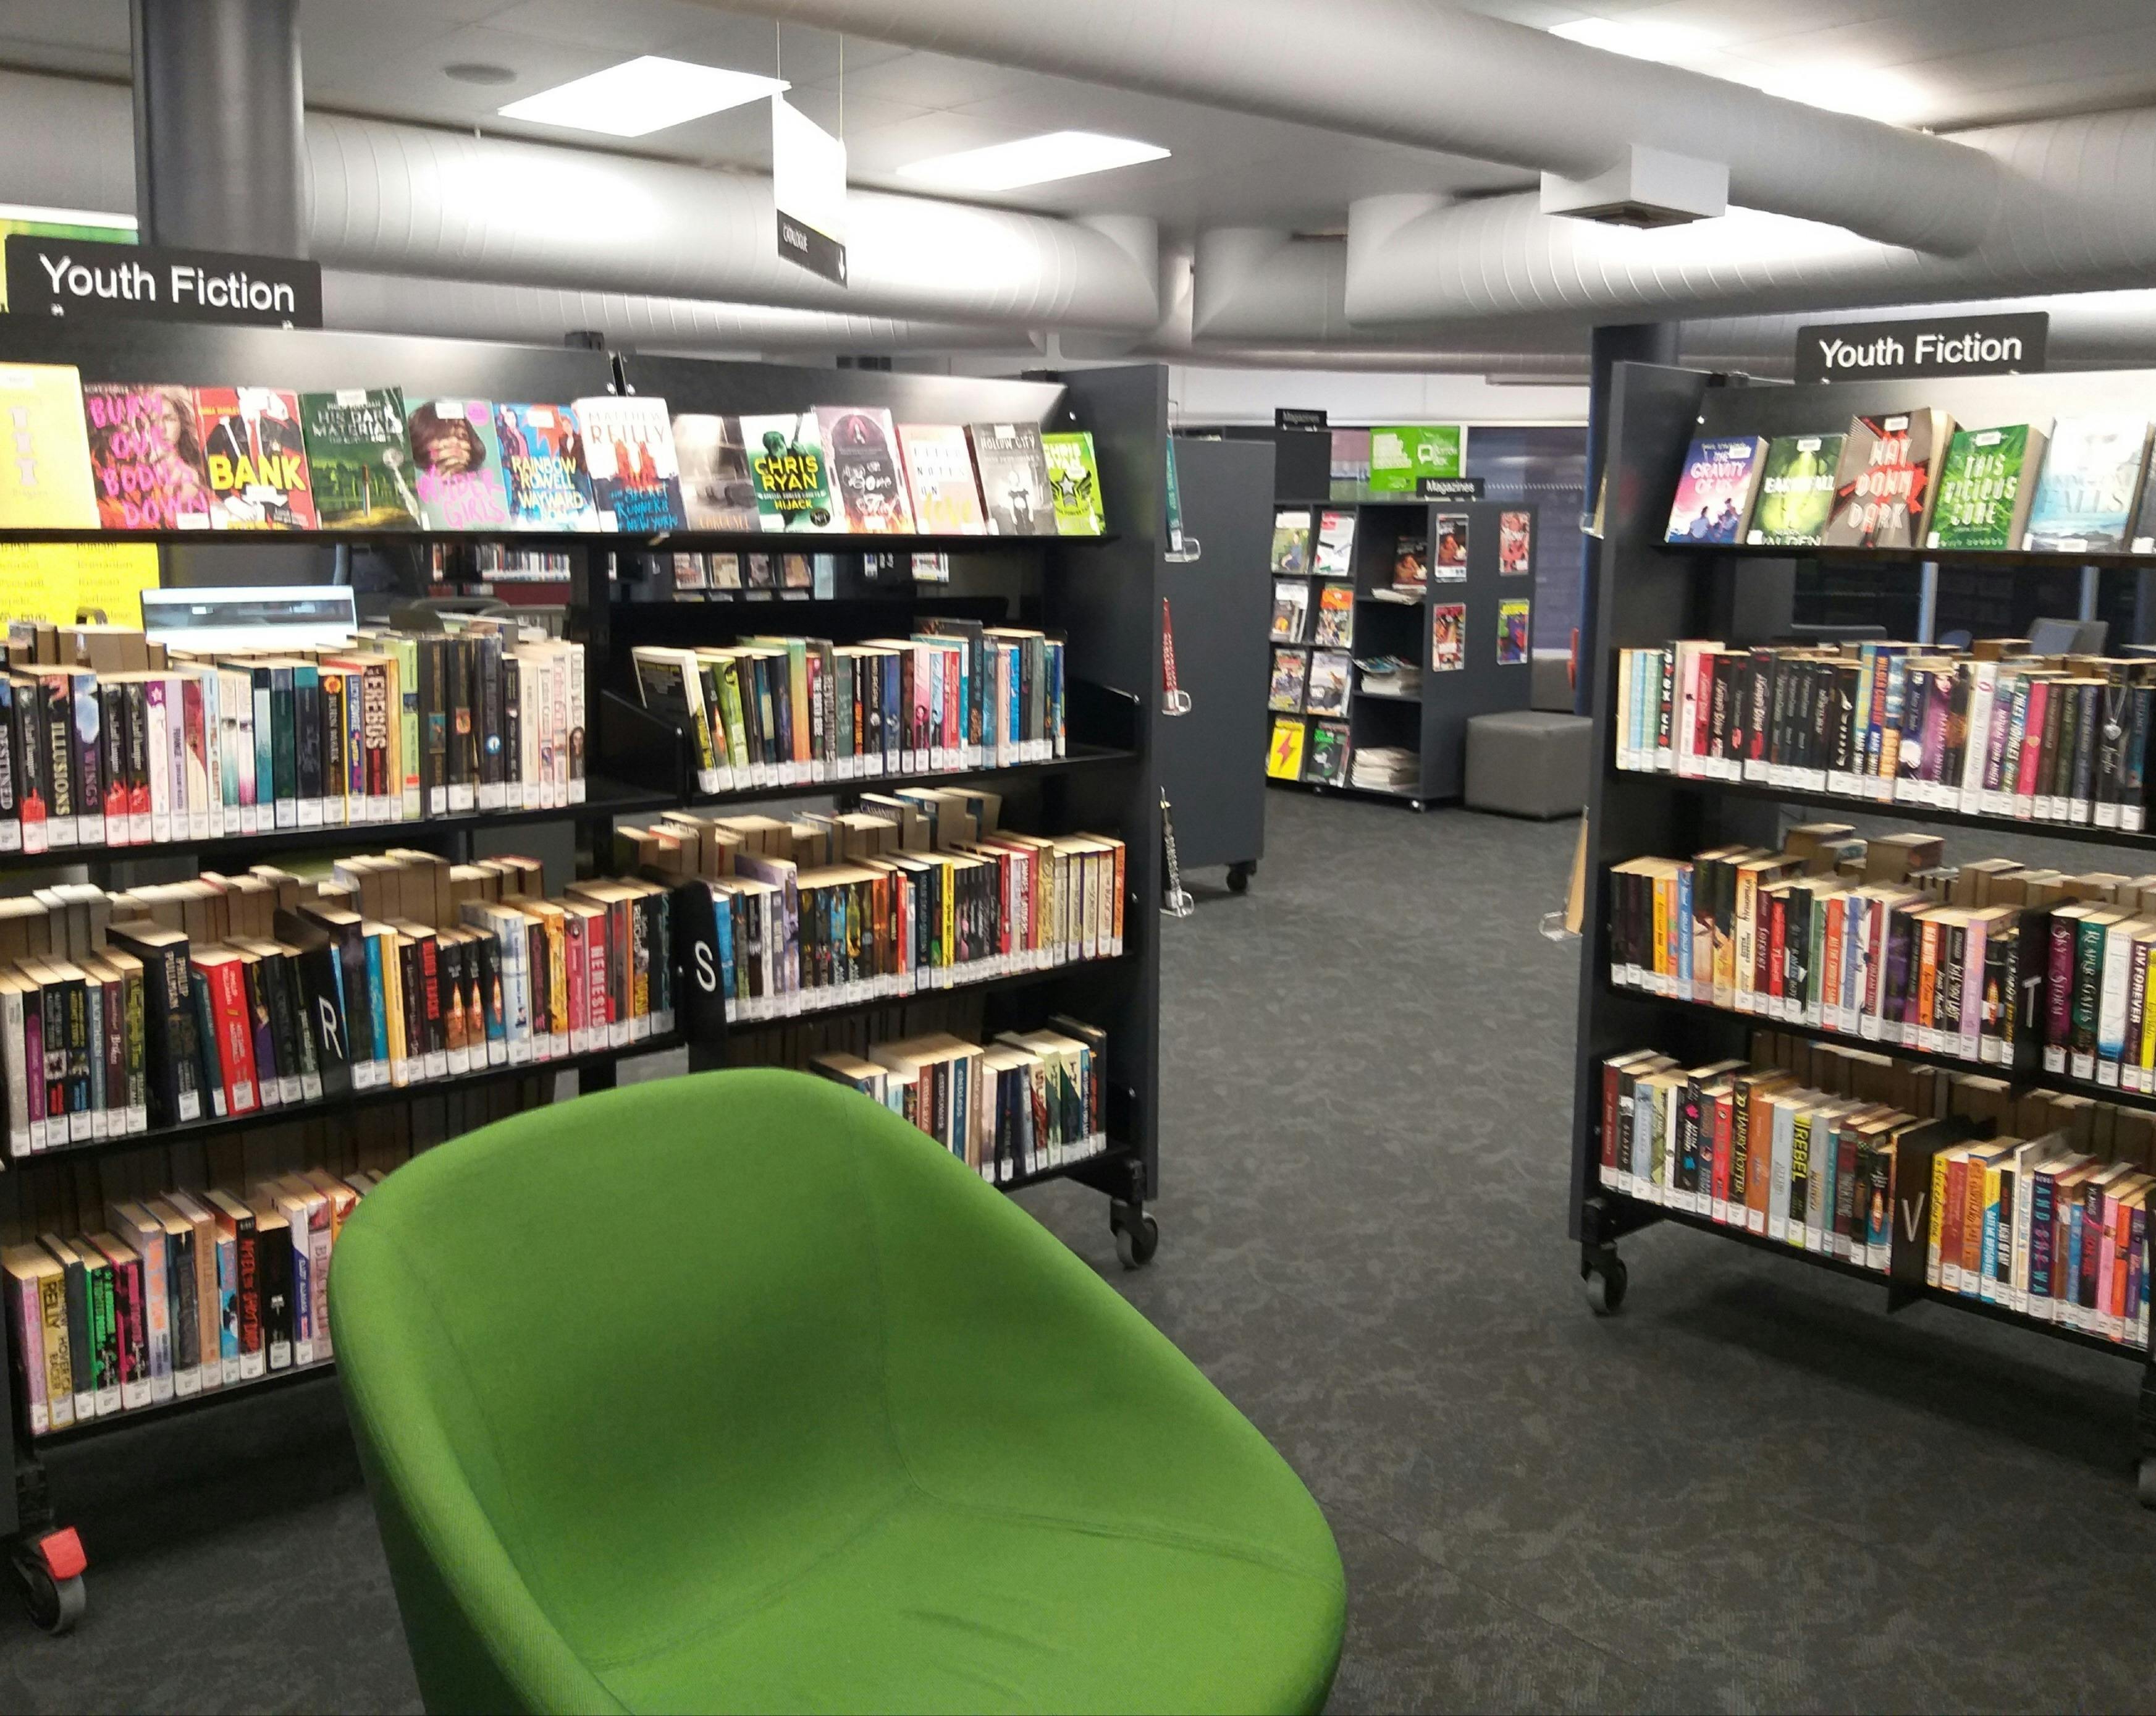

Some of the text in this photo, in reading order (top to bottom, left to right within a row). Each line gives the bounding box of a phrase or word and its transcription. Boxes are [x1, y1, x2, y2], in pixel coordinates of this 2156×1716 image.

[40, 253, 295, 312] Youth Fiction
[1819, 332, 2022, 368] Youth Fiction
[590, 425, 665, 444] REILLY
[980, 434, 1035, 450] HOLLOW CITY
[208, 454, 306, 491] BANK
[512, 455, 576, 475] RAINBOW
[519, 472, 575, 491] ROWELL
[754, 455, 819, 475] CHRIS
[761, 473, 817, 492] RYAN
[1691, 462, 1745, 479] GRAVITY
[1855, 467, 1914, 499] DOWN
[517, 489, 585, 510] WAYWARD
[774, 499, 813, 511] HIJACK
[1426, 480, 1475, 494] Magazines
[443, 496, 505, 530] GIRLS
[1848, 502, 1906, 533] DARK
[364, 675, 387, 750] EREBOS
[1937, 712, 1948, 742] MARIA
[2007, 692, 2027, 761] MILES MORALES
[1853, 731, 1866, 775] MARK SMITH
[1871, 731, 1880, 752] MARK
[1987, 708, 2008, 787] NATURAL BORN ANGEL
[51, 721, 70, 816] ILLUSIONS
[84, 750, 98, 806] WINGS
[1867, 752, 1879, 776] SMITH
[694, 940, 717, 992] S
[1758, 927, 1769, 971] forever
[2080, 929, 2100, 975] REAPER
[589, 945, 606, 1026] NEMESIS
[1948, 962, 1964, 983] KILL
[2049, 925, 2070, 1017] SKY STORM
[1945, 999, 1961, 1021] LAST
[1947, 983, 1961, 1000] YOU
[2022, 976, 2042, 1028] T
[2130, 968, 2146, 1024] FOREVER
[318, 994, 343, 1060] R
[1621, 1124, 1630, 1164] SLATED
[1735, 1110, 1749, 1194] HARRY POTTER
[1792, 1126, 1809, 1183] REBEL
[1901, 1191, 1926, 1243] V
[2087, 1186, 2097, 1215] VLAHOS
[1998, 1222, 2010, 1242] LIGHT
[2032, 1185, 2051, 1293] AND SHE WA
[315, 1245, 327, 1301] BLACK
[44, 1282, 61, 1329] REILLY
[59, 1337, 70, 1375] HOVER
